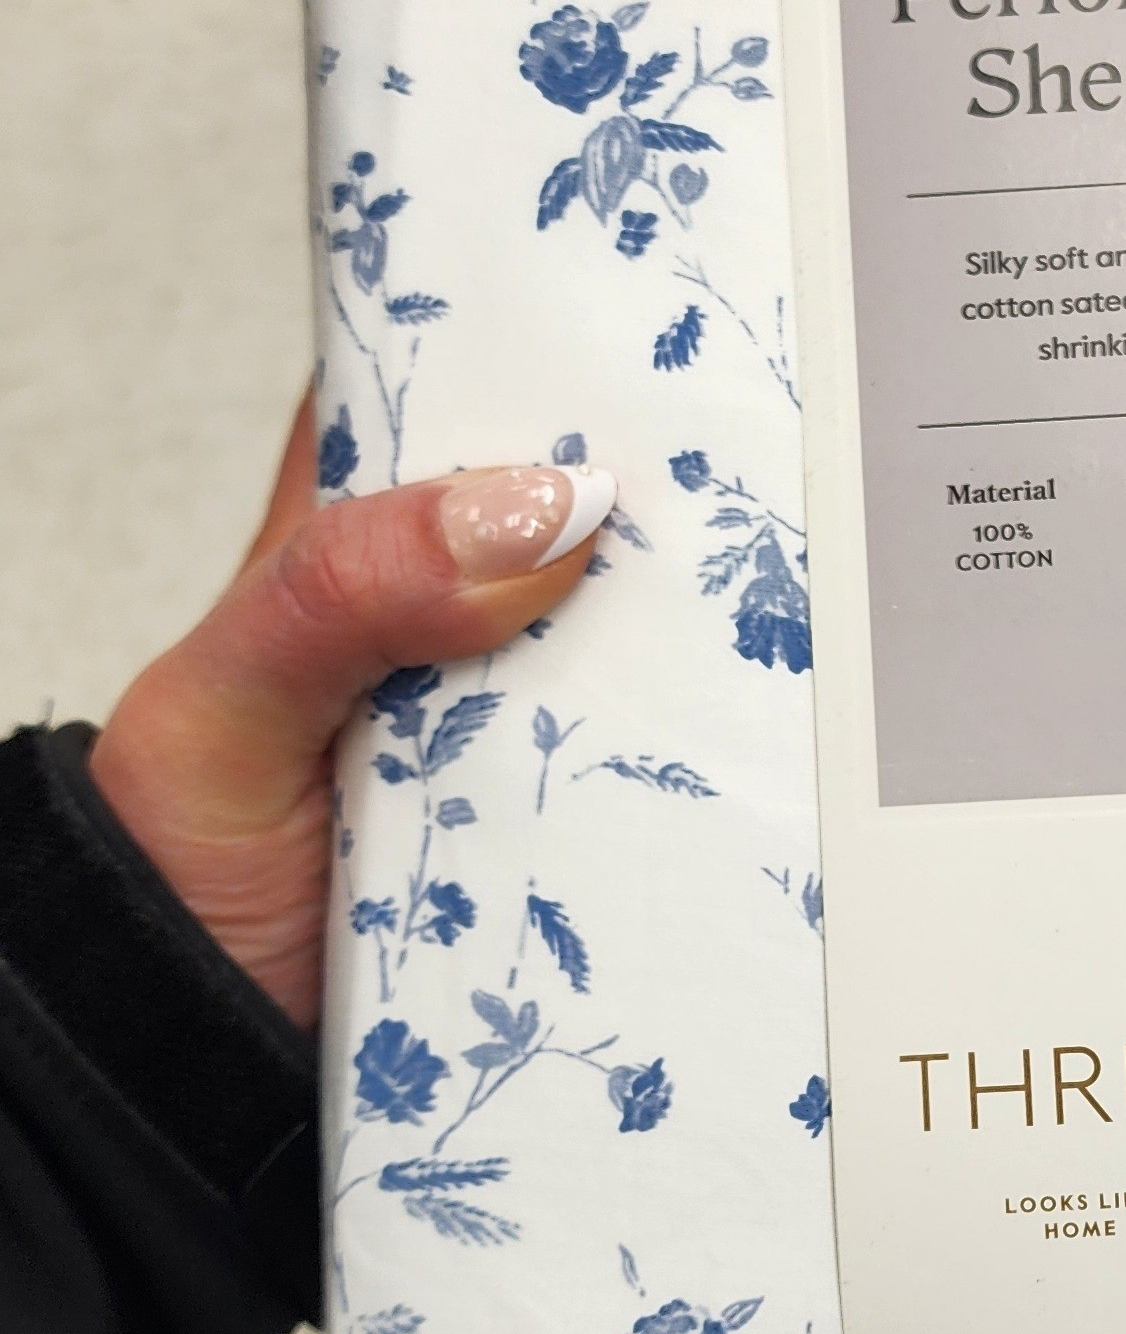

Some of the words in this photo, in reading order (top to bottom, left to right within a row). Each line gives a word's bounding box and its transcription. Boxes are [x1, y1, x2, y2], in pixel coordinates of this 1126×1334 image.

[964, 250, 1029, 281] Silky
[1034, 245, 1090, 272] soft
[959, 297, 1055, 321] cotton
[945, 477, 1057, 506] Material
[972, 521, 1034, 544] 100%
[954, 548, 1054, 572] COTTON
[1004, 1193, 1088, 1214] LOOKS
[1044, 1219, 1116, 1240] HOME
